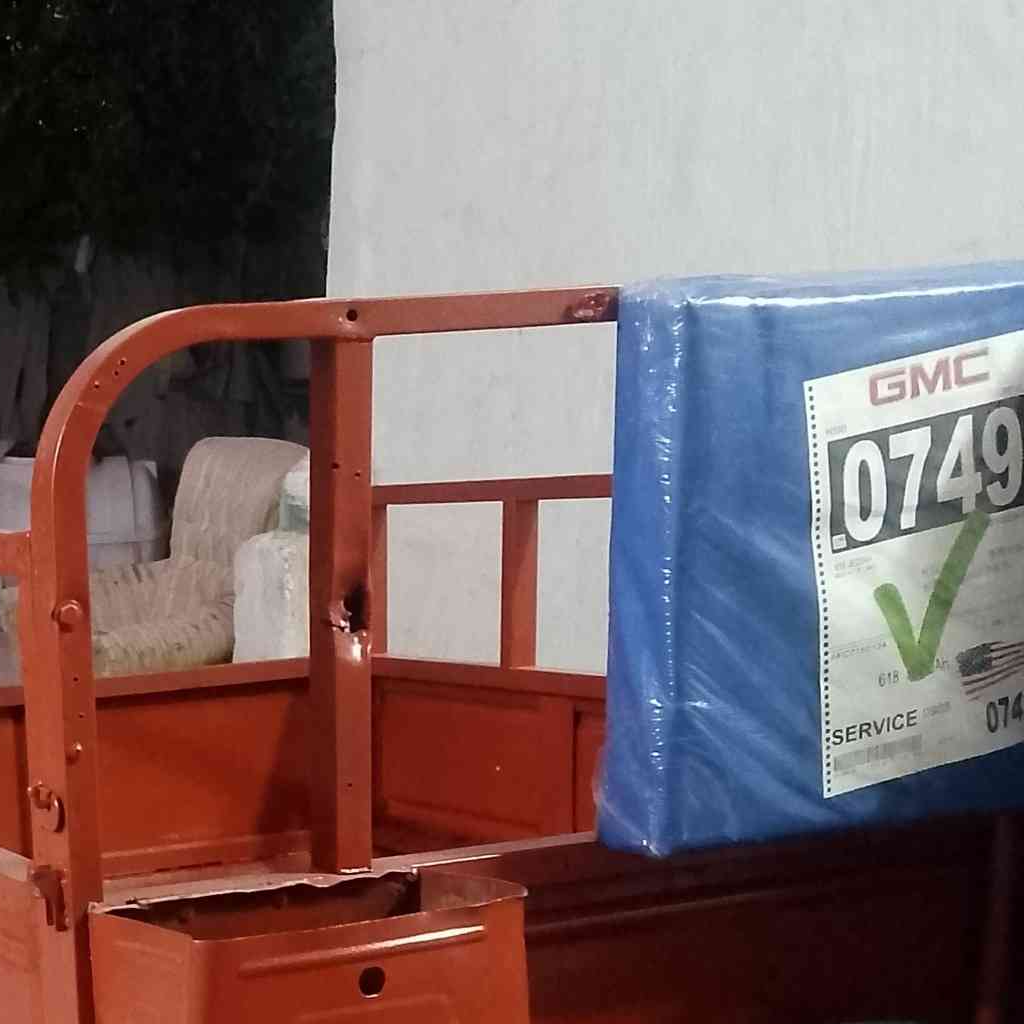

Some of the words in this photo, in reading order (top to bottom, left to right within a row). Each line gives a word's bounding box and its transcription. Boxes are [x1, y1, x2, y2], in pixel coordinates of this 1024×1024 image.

[869, 347, 990, 406] GMC
[843, 406, 1024, 542] 0749
[832, 709, 918, 746] SERVICE
